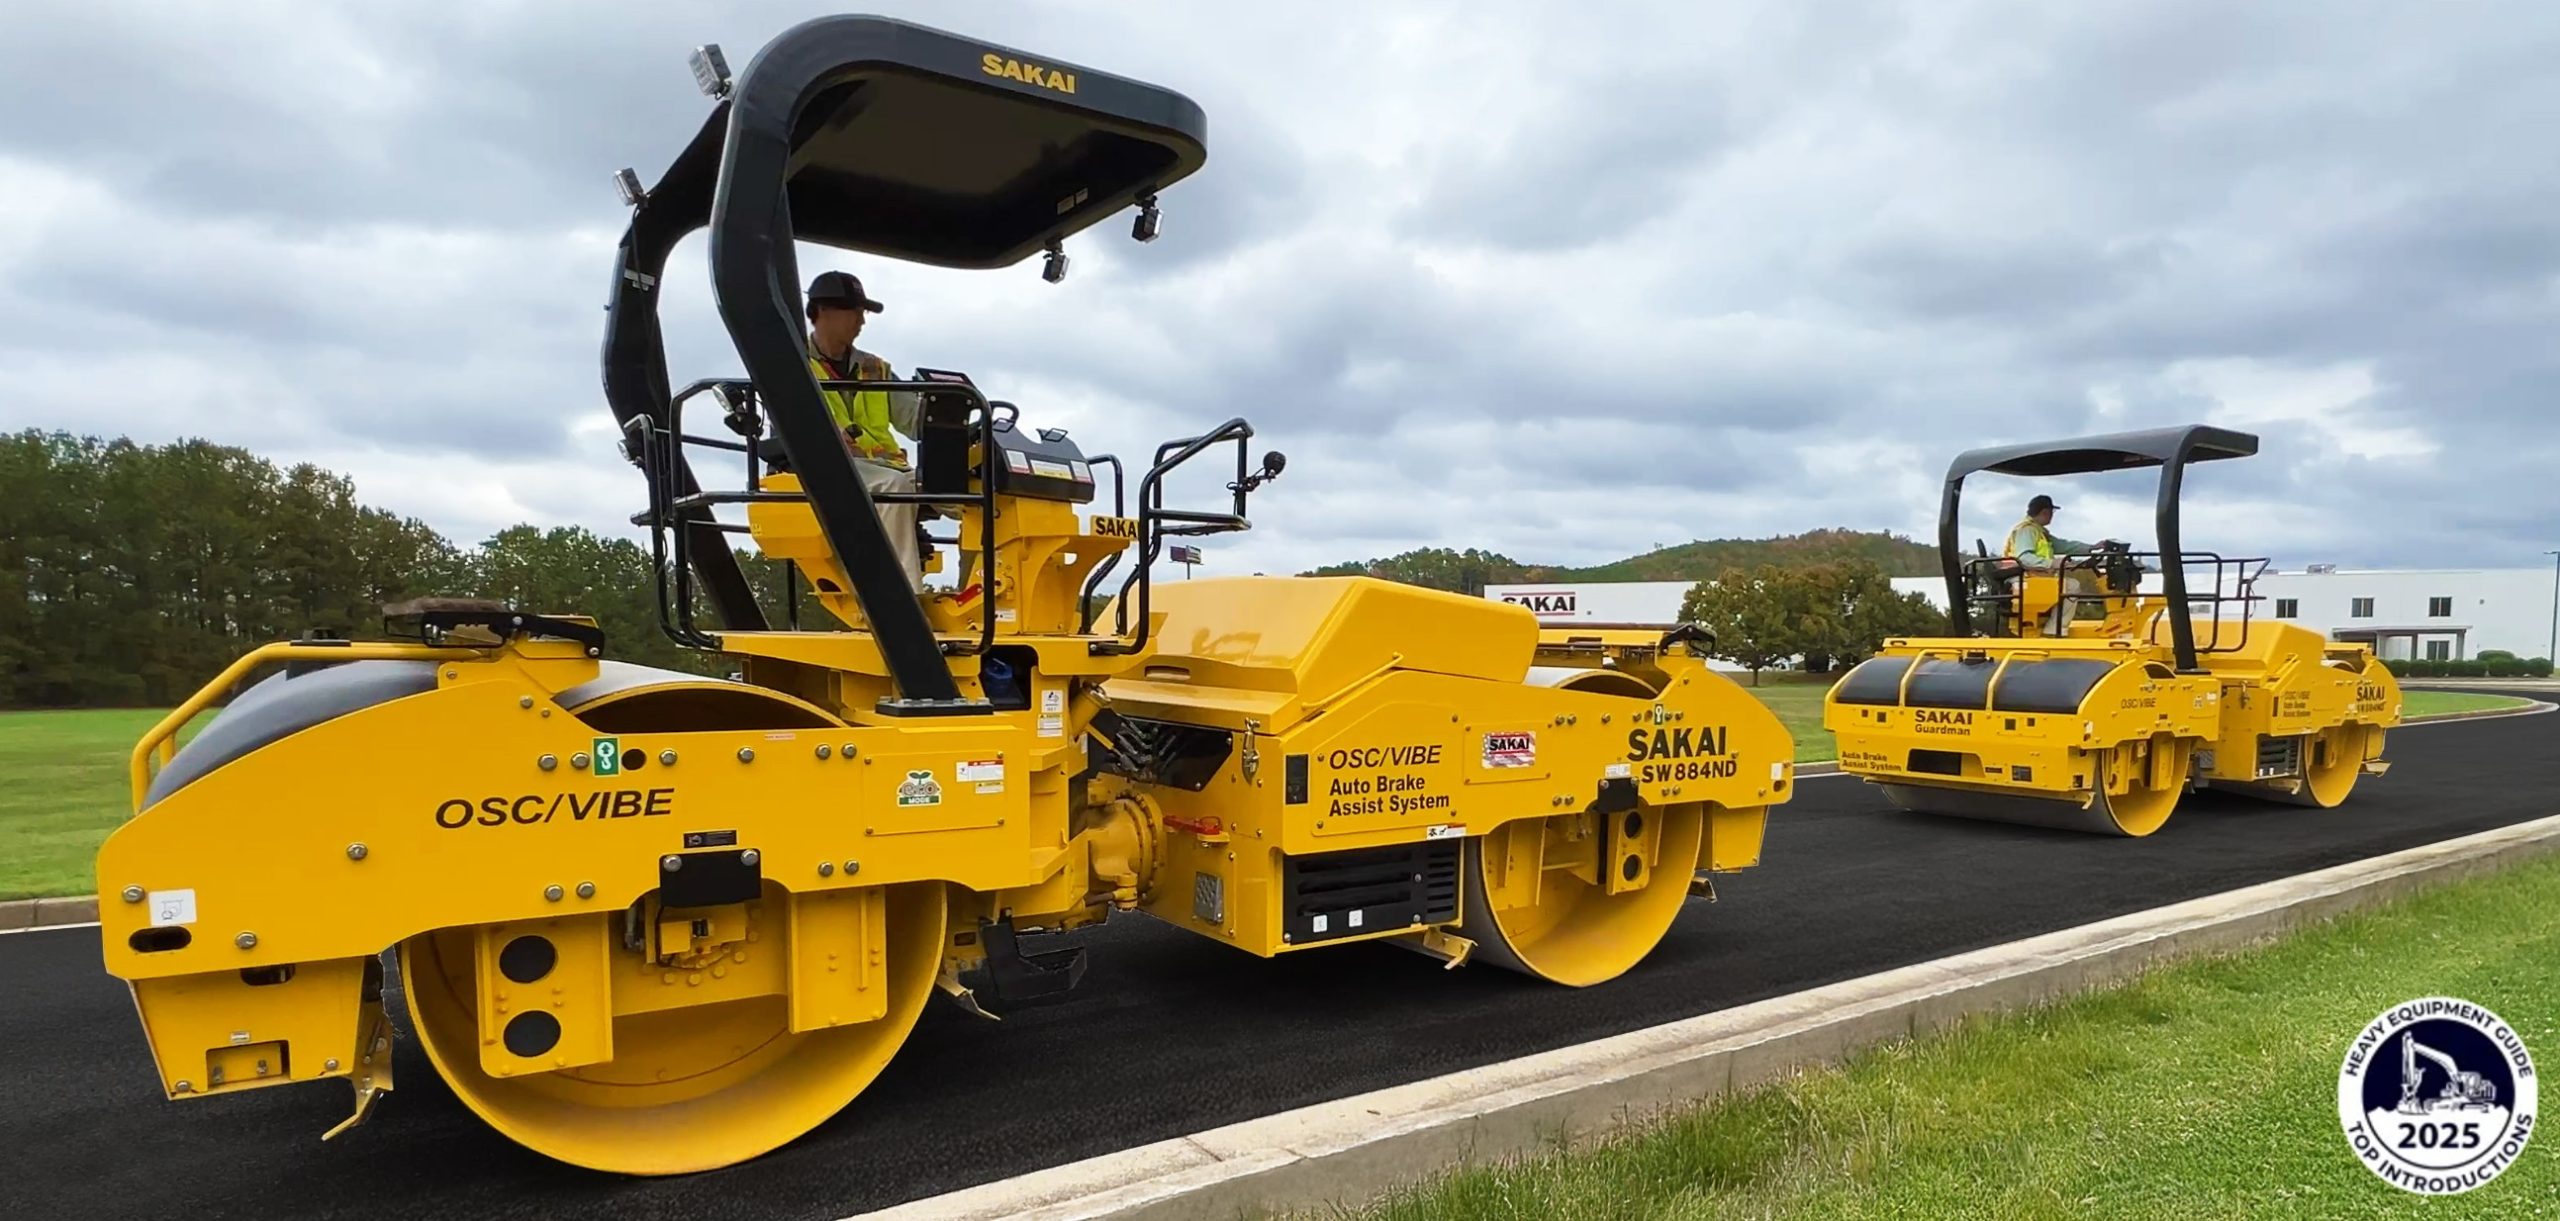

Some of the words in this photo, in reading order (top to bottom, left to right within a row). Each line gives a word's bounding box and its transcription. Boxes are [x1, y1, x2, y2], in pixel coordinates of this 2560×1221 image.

[982, 53, 1075, 94] SAKAI
[1095, 516, 1141, 538] SAKA
[2356, 686, 2385, 701] SAKAI
[1915, 710, 1972, 725] SAKAI
[1915, 724, 1971, 736] Guardman
[1489, 738, 1530, 751] SAKAI
[1627, 726, 1726, 762] SAKAI
[1329, 745, 1442, 770] OSC/VIBE
[1329, 778, 1371, 796] Auto
[1377, 774, 1425, 793] Brake
[435, 788, 675, 829] OSC/VIBE
[1329, 797, 1384, 817] Assist
[1389, 794, 1449, 815] System
